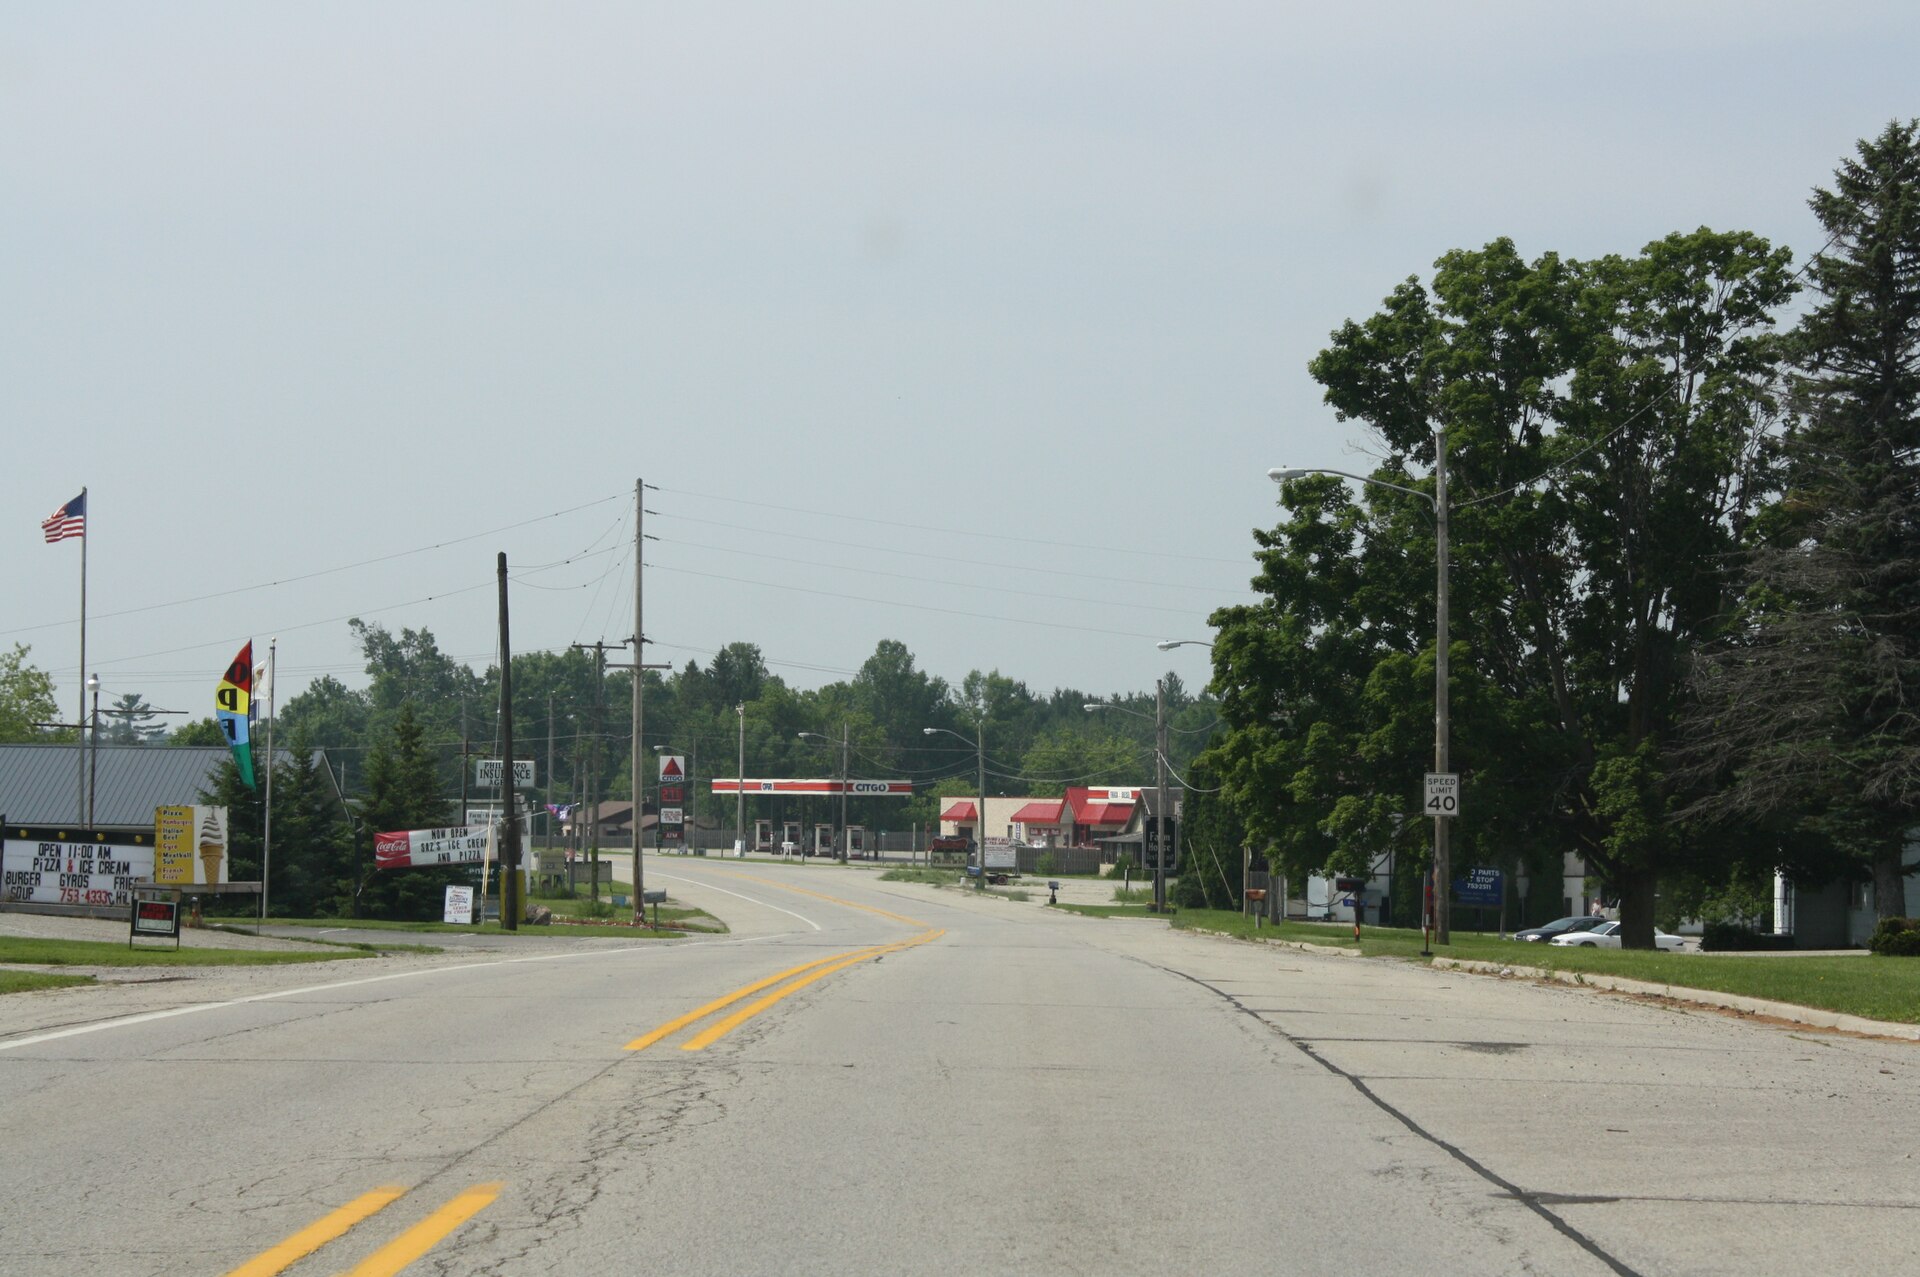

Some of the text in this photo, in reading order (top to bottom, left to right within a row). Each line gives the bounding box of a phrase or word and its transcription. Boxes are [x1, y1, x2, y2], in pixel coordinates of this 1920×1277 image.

[855, 783, 887, 792] CITGO
[1427, 796, 1456, 811] 40
[431, 828, 468, 839] NOW OPEN
[38, 843, 111, 860] OPEN 11:00 AM
[376, 840, 407, 852] Coca-Cola
[437, 850, 481, 863] AND PIZZA
[67, 859, 73, 873] &
[79, 861, 94, 874] ICE
[98, 861, 130, 875] CREAM
[1478, 869, 1500, 877] PARTS
[5, 872, 41, 886] BURGER
[59, 874, 89, 888] GYROS
[10, 887, 34, 900] SOUP
[60, 888, 109, 904] 753-4333
